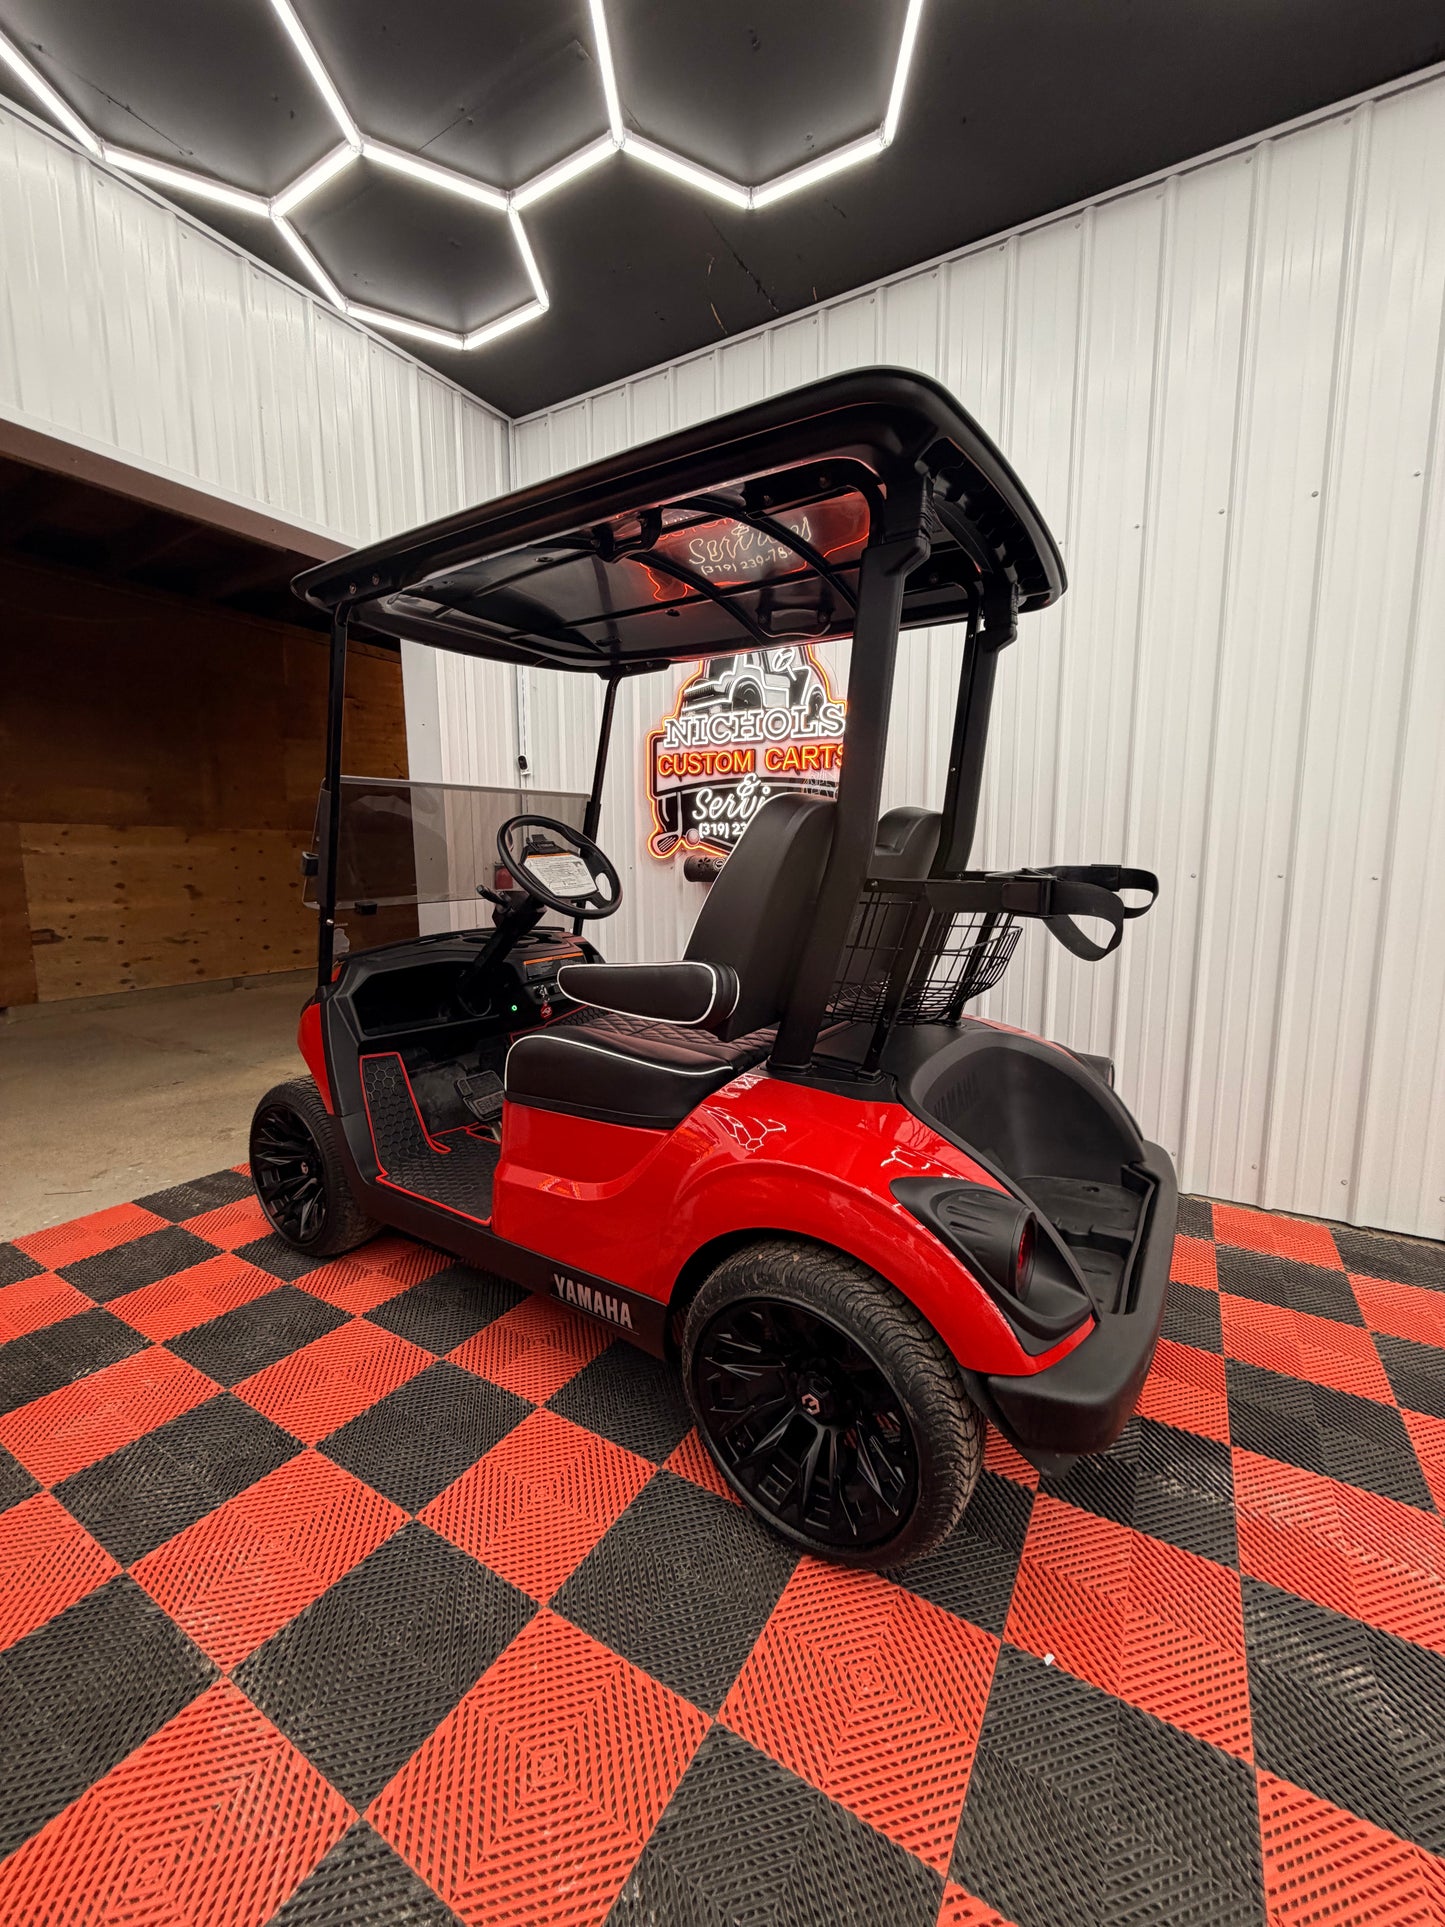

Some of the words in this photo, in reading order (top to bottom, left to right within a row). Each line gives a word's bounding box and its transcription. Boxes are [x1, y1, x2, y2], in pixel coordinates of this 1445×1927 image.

[664, 703, 846, 748] NICHOLS
[657, 750, 756, 777] CUSTOM
[736, 772, 762, 800] &
[698, 821, 731, 840] (319)
[553, 1273, 633, 1329] YAMAHA
